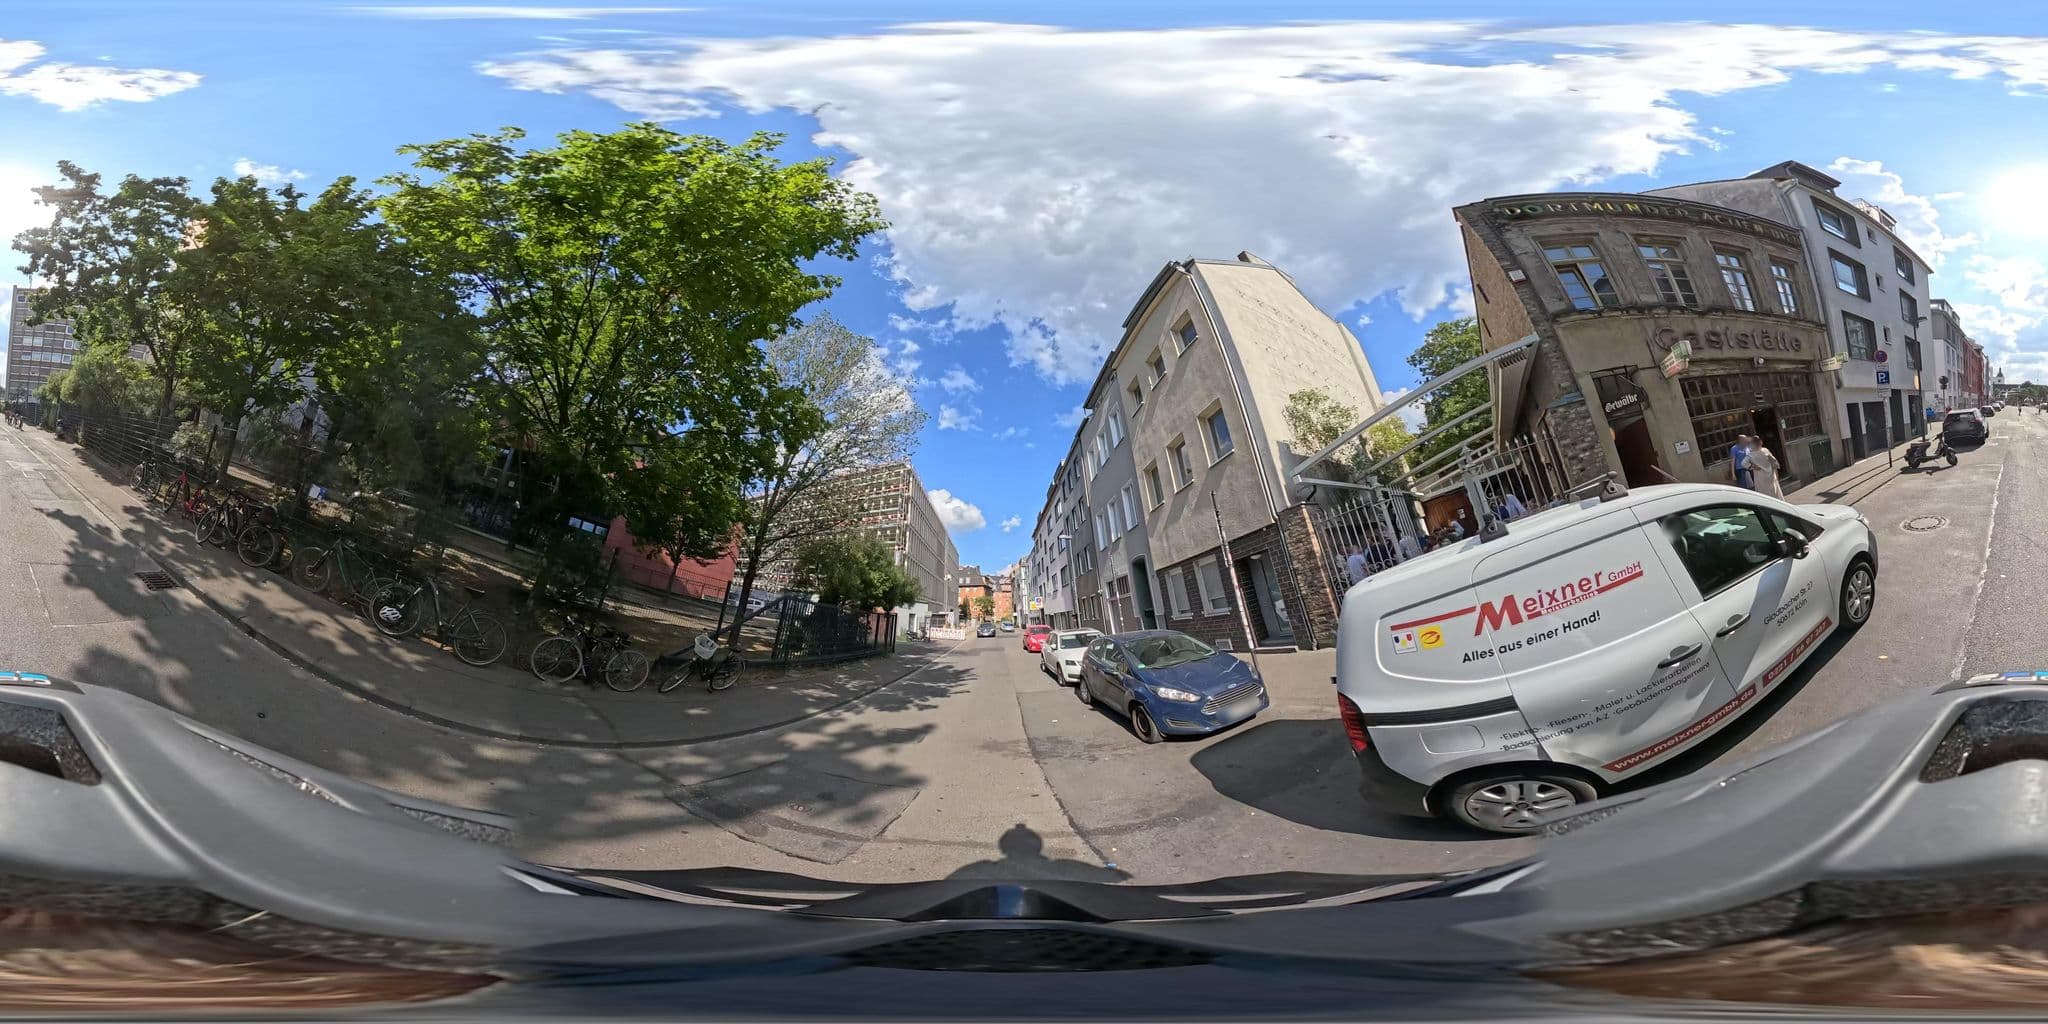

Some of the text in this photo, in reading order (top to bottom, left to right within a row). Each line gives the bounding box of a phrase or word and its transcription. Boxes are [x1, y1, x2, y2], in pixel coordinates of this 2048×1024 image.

[1654, 325, 1803, 352] Gaststätte
[1605, 393, 1638, 413] Gewölbe
[1474, 561, 1642, 637] Meixner GmbH
[1541, 590, 1599, 615] Meisterbetrieb
[1462, 610, 1601, 664] Alles aus einer Hand!
[1625, 692, 1635, 701] u.
[1636, 657, 1702, 696] Lackierarbeiten
[1575, 720, 1595, 731] von
